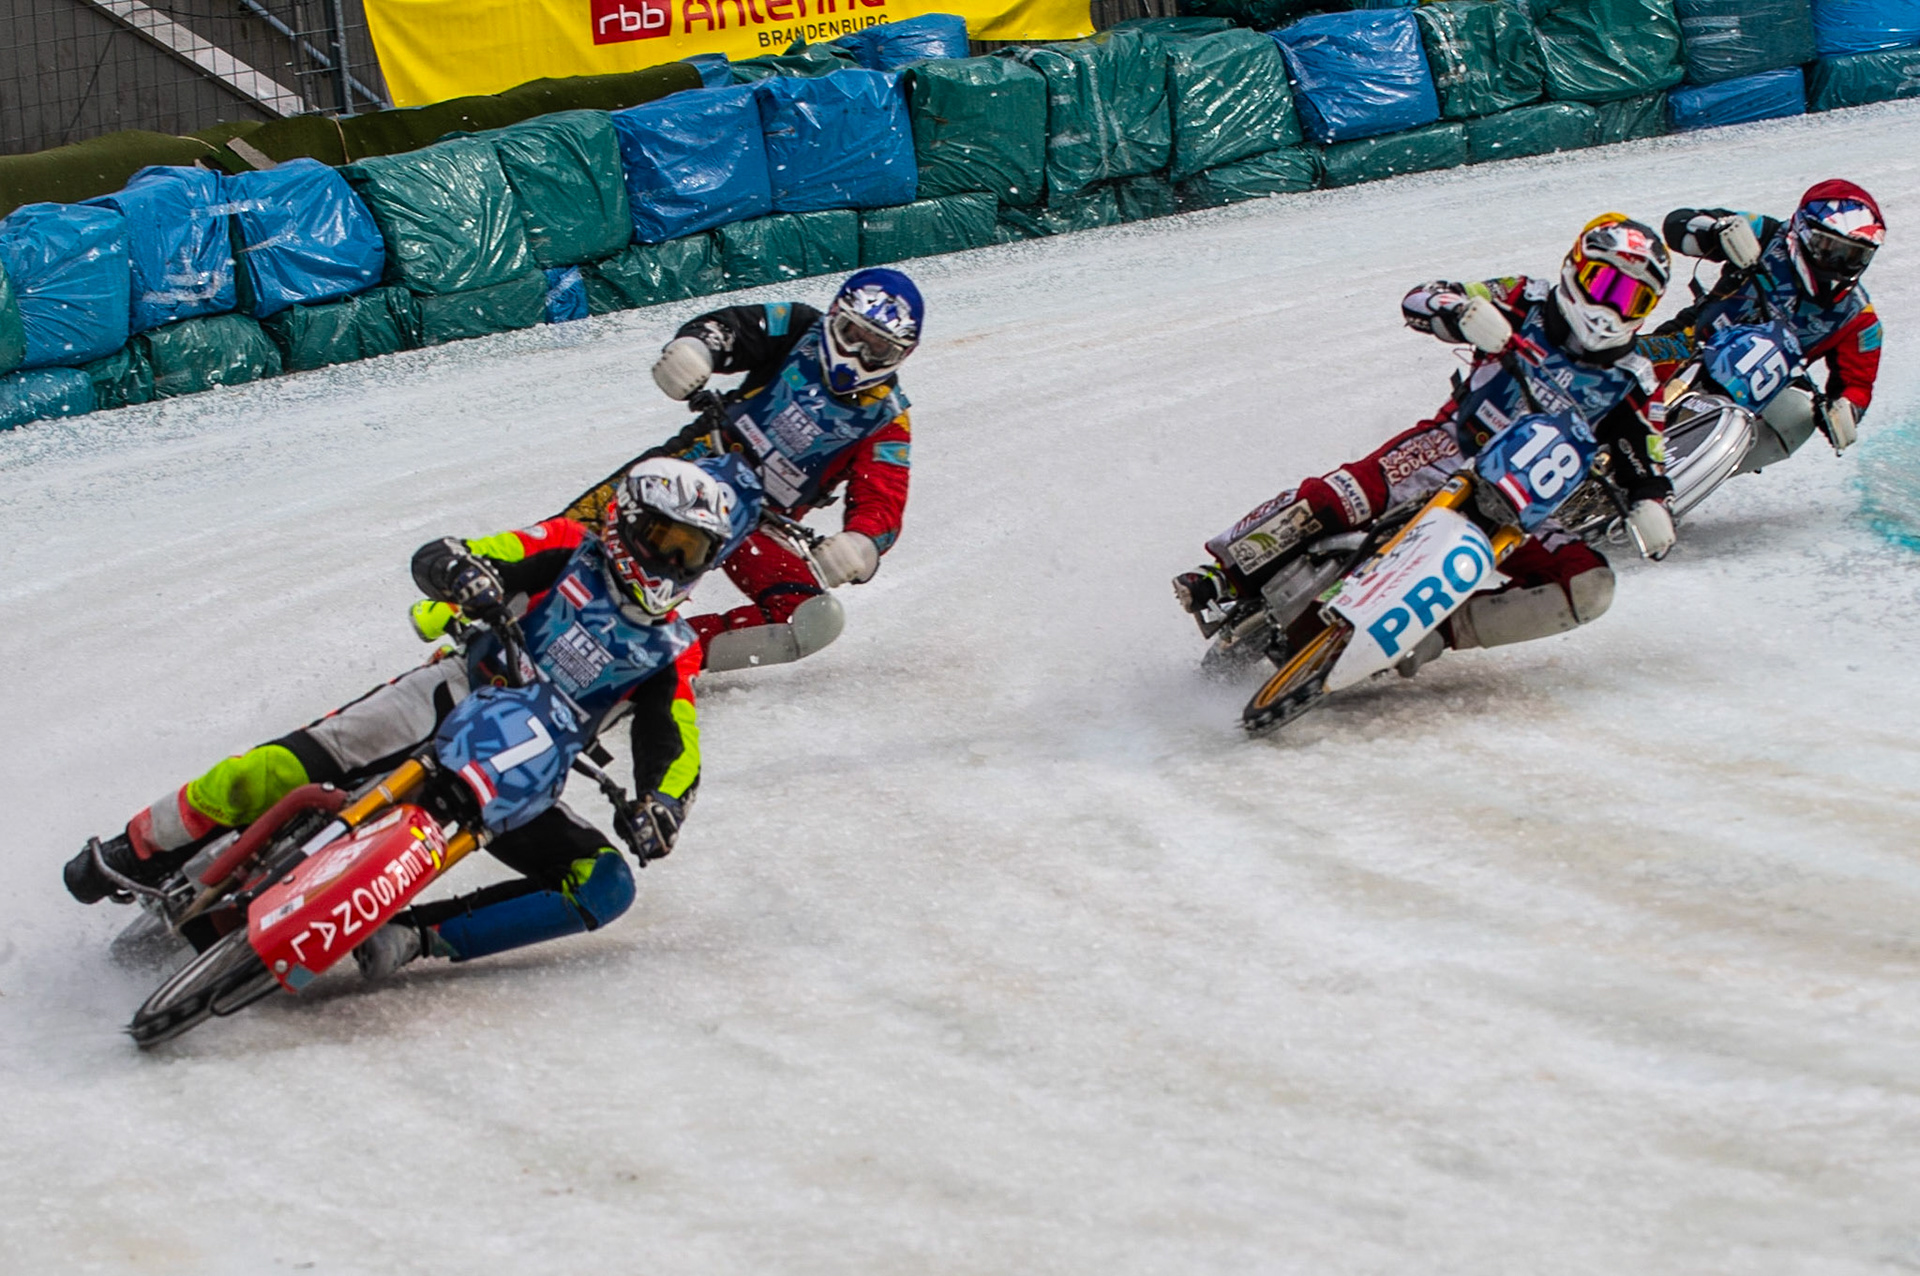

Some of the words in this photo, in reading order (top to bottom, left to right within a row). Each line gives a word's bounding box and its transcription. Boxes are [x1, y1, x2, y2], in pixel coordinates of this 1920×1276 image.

[599, 1, 665, 34] rbb
[1553, 368, 1574, 389] 18
[1734, 335, 1790, 402] 15
[1509, 422, 1581, 500] 18
[563, 624, 611, 672] ICE
[290, 839, 433, 962] PERSONAL
